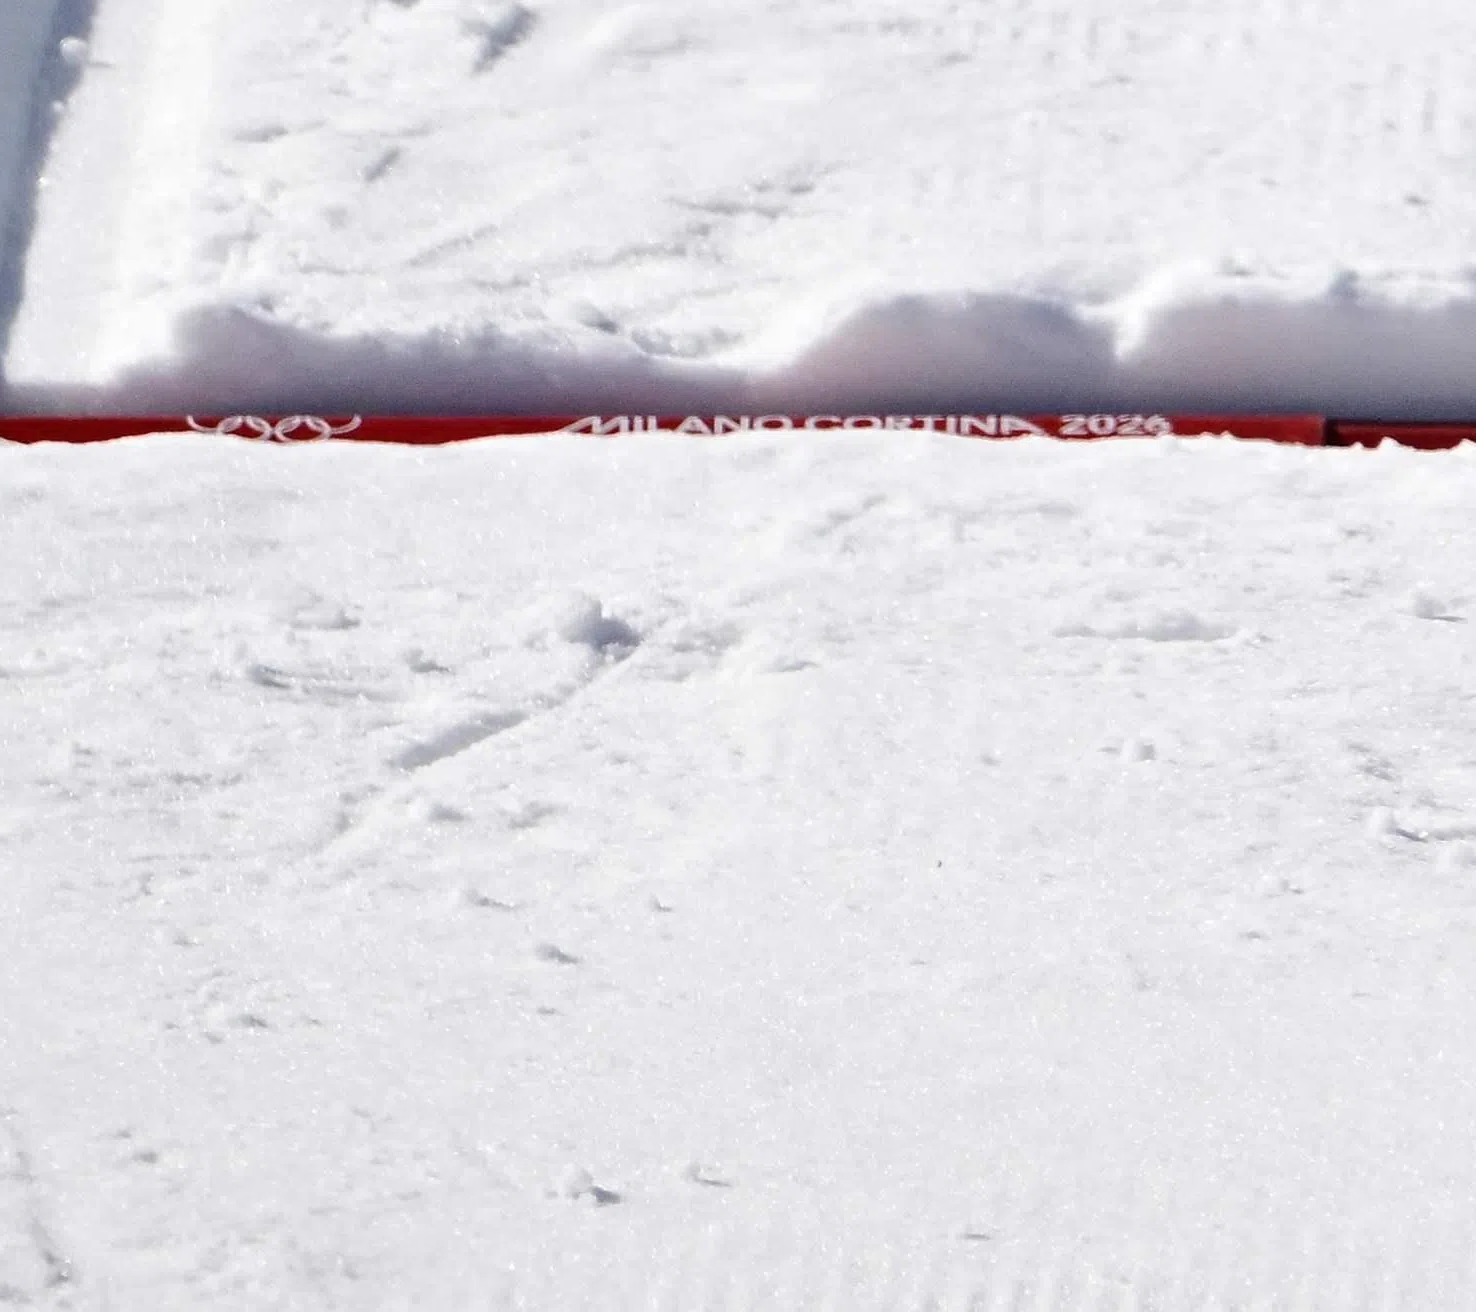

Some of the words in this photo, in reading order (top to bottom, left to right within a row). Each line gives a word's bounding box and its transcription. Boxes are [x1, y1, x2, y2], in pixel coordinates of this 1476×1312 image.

[557, 415, 793, 435] MILANO
[804, 414, 1049, 436] CORTINA
[1058, 414, 1174, 437] 2026
